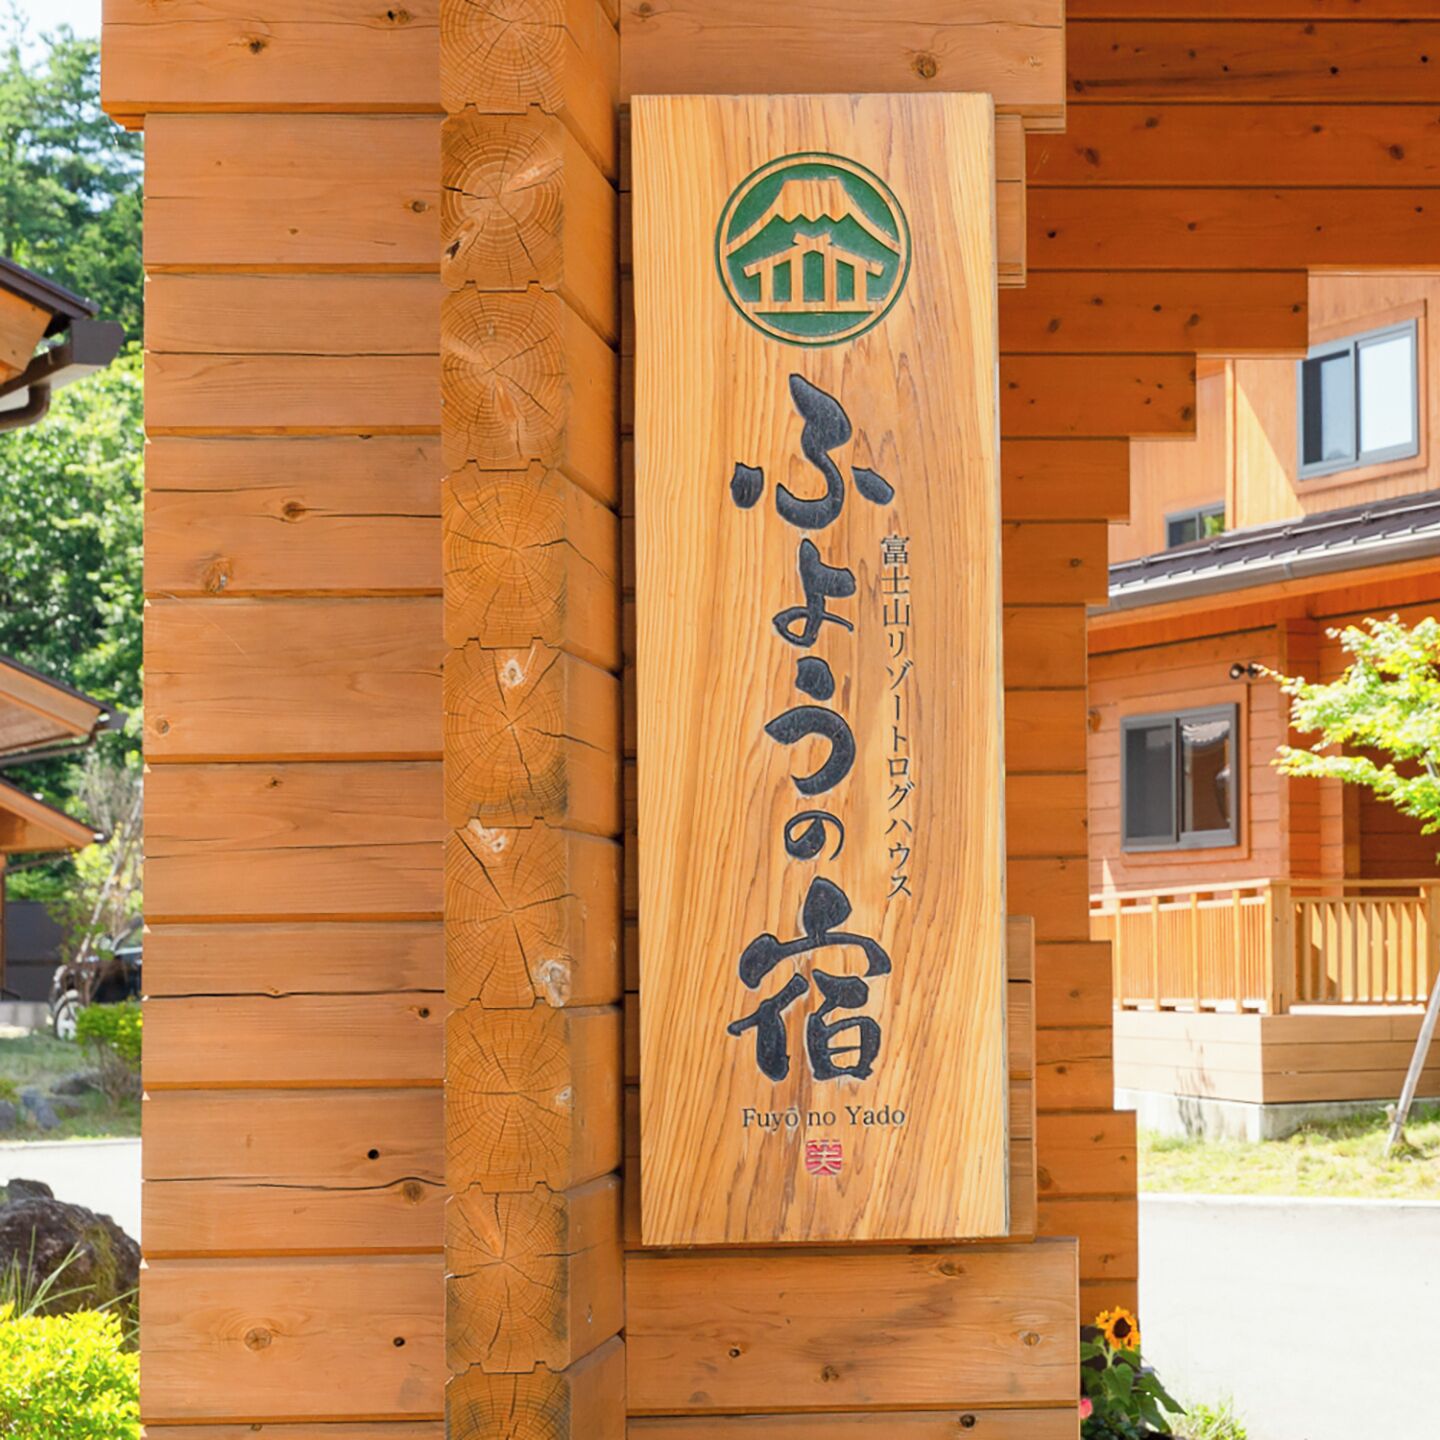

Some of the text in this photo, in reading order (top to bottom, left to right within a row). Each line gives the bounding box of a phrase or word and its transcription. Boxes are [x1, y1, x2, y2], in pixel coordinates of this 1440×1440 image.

[727, 373, 895, 1082] ふようの宿
[880, 534, 915, 899] 富士山リゾートログハウス
[807, 1111, 836, 1127] no
[845, 1105, 906, 1127] Yado
